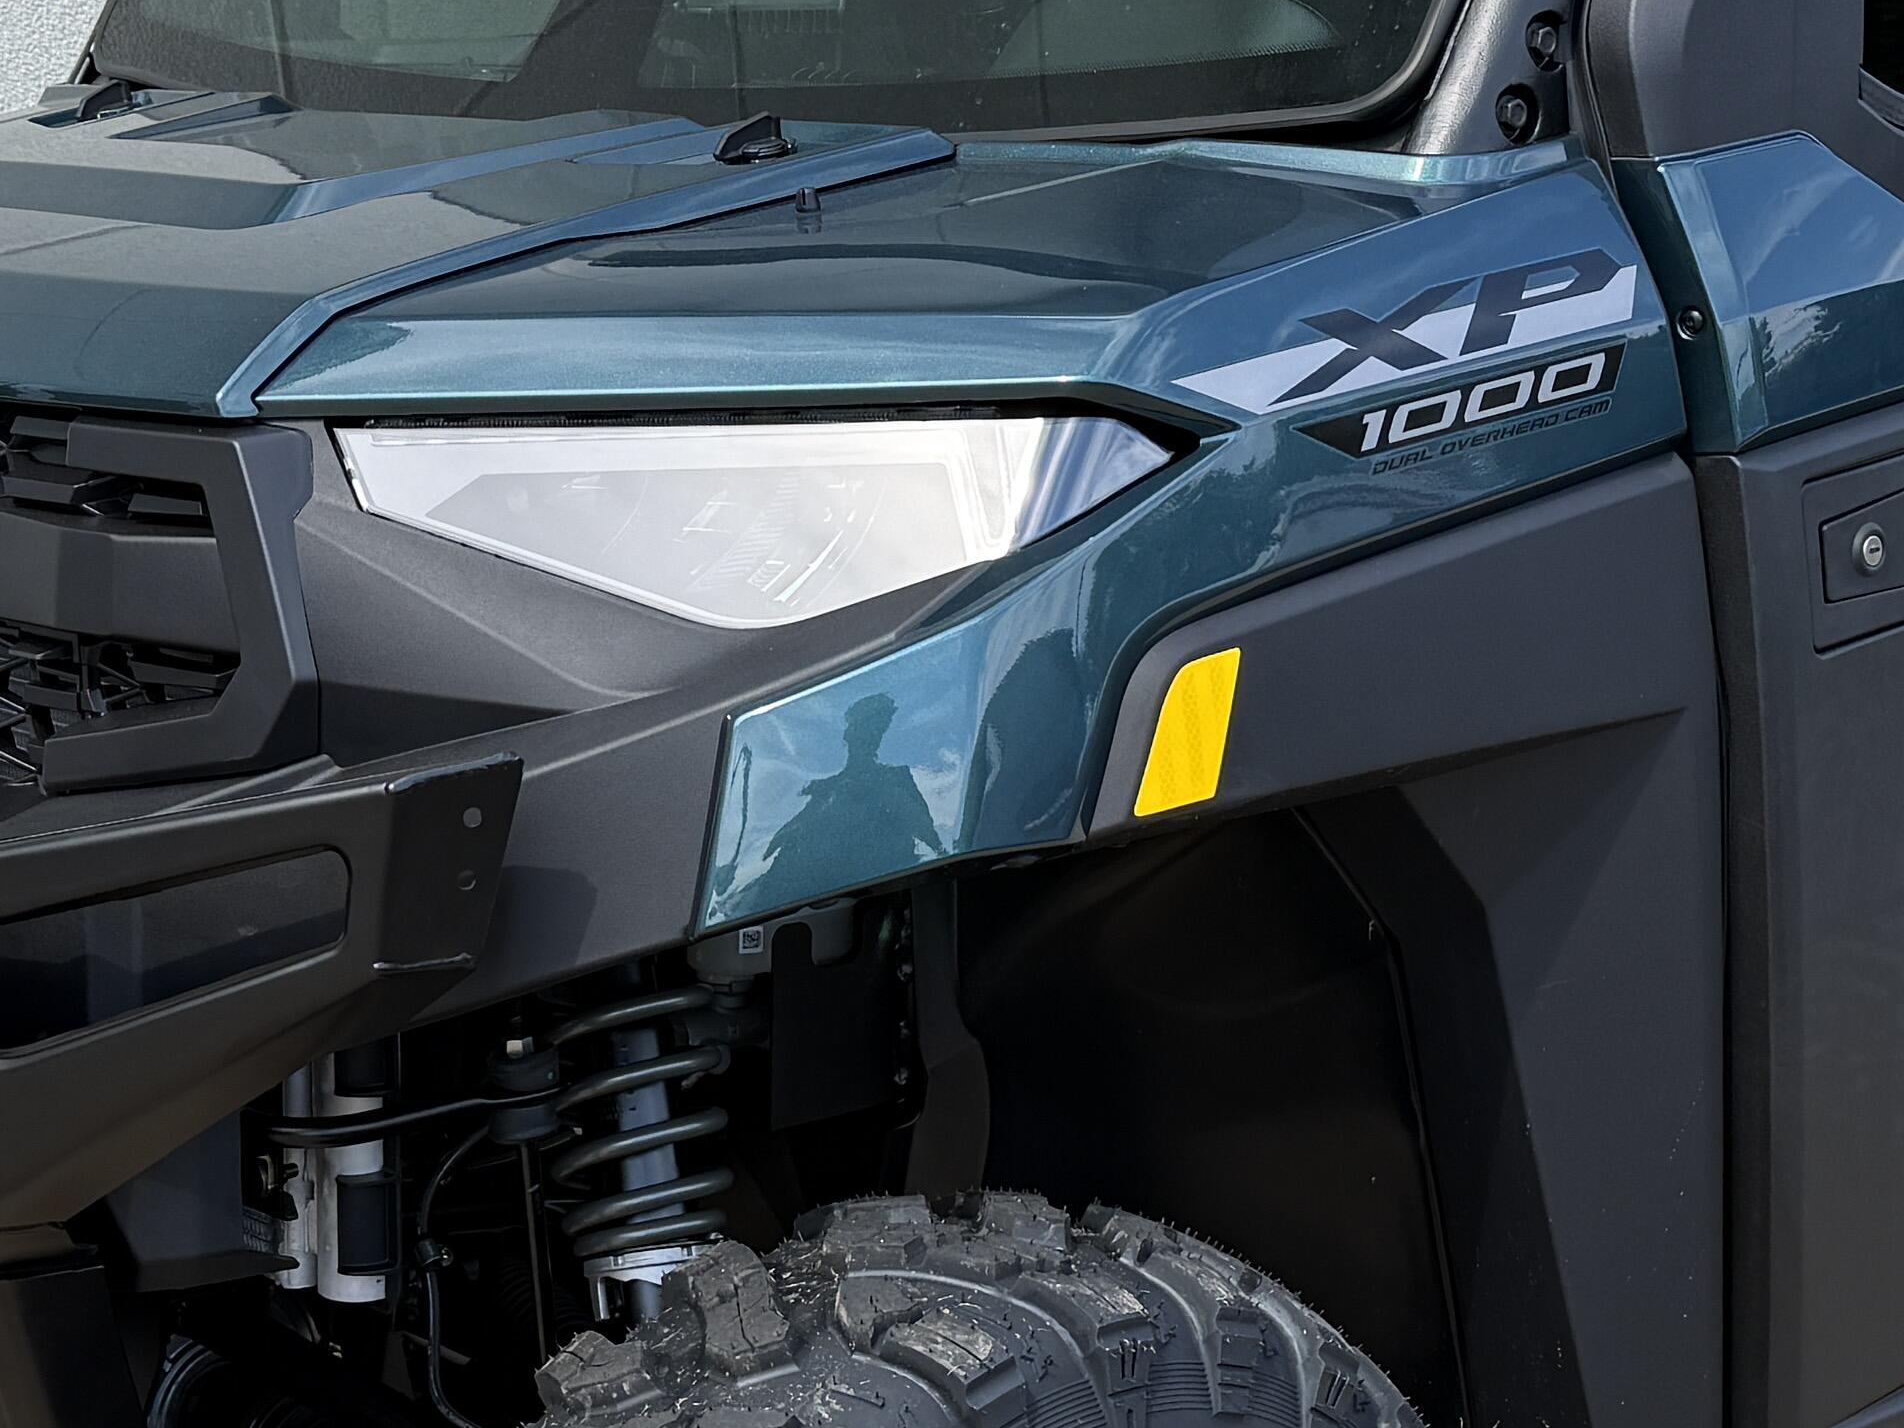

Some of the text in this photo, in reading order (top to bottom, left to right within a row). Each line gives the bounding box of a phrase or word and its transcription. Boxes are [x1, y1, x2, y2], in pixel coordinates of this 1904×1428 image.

[1266, 249, 1622, 408] XP
[1361, 352, 1606, 453] 1000
[1373, 396, 1612, 476] DUAL OVERHEAD CAM
